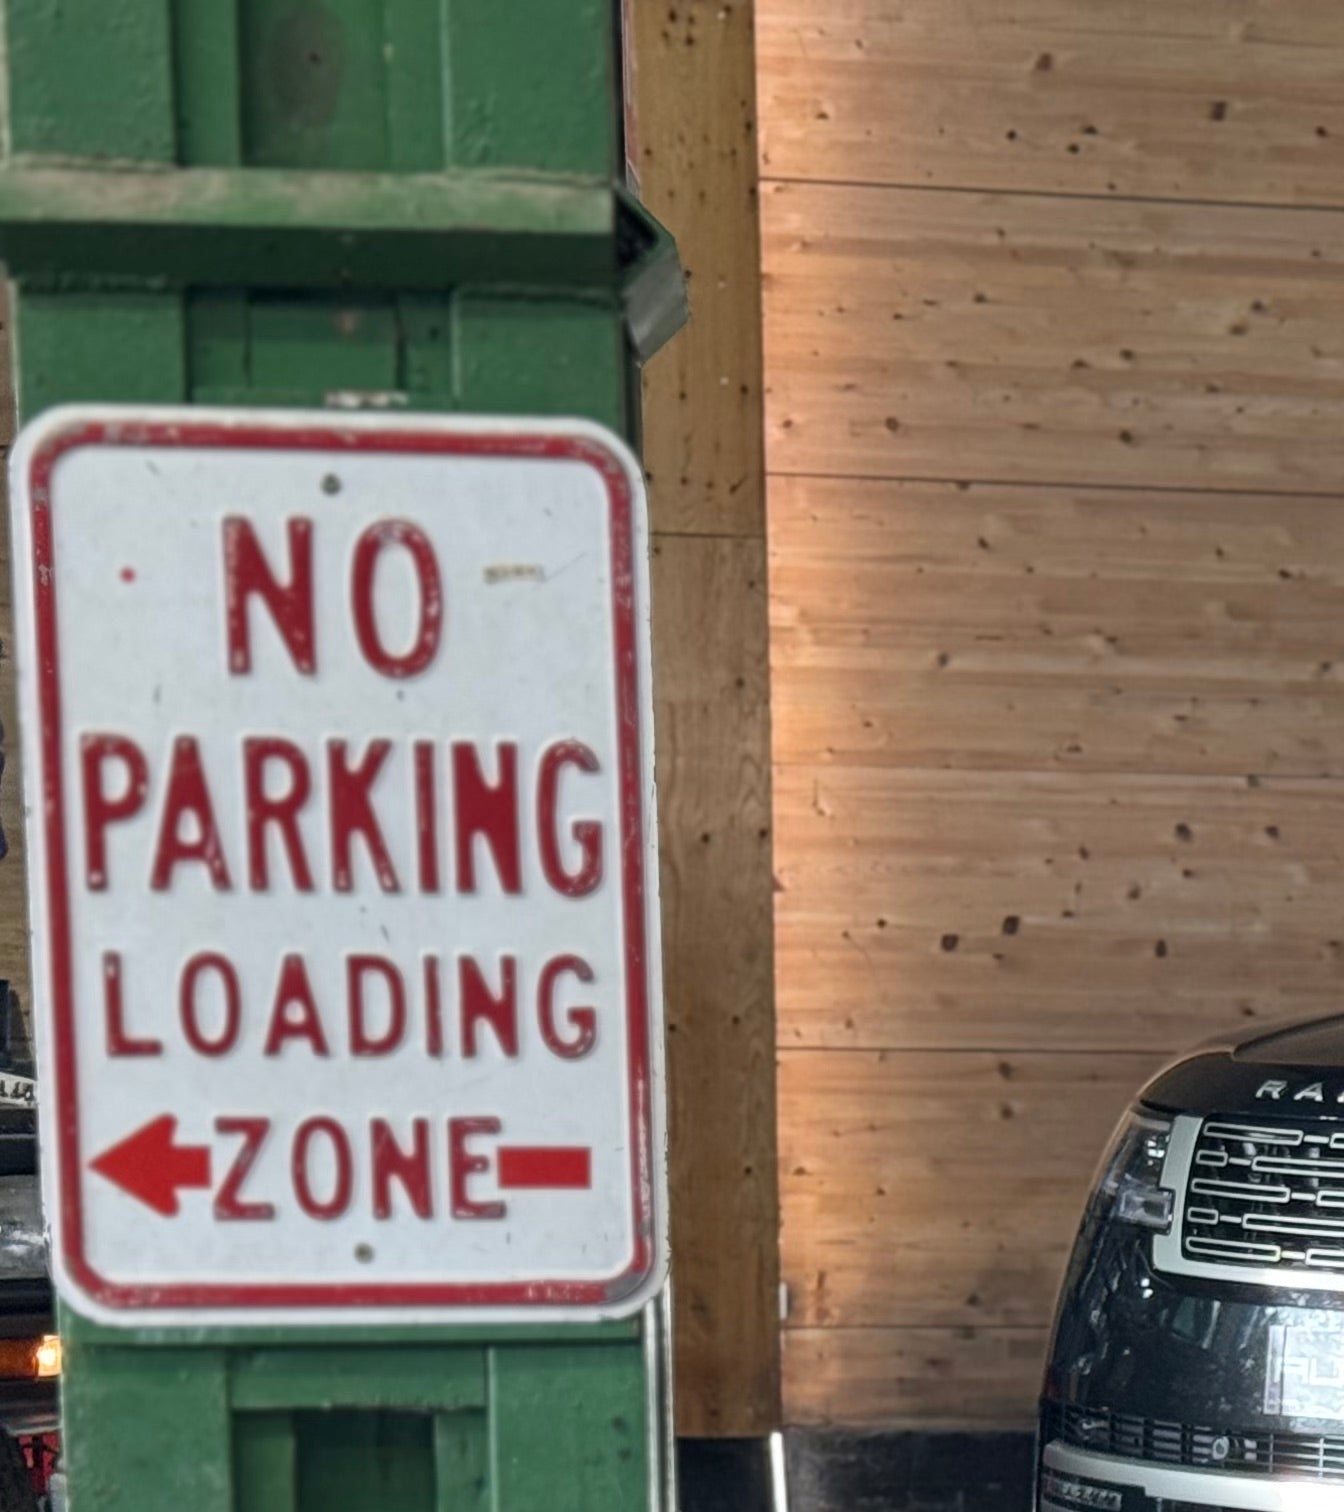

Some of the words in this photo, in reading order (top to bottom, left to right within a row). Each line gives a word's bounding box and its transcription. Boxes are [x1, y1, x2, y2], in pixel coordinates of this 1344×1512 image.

[221, 513, 444, 679] NO
[79, 732, 604, 898] PARKING
[103, 951, 598, 1060] LOADING
[214, 1115, 506, 1222] ZONE
